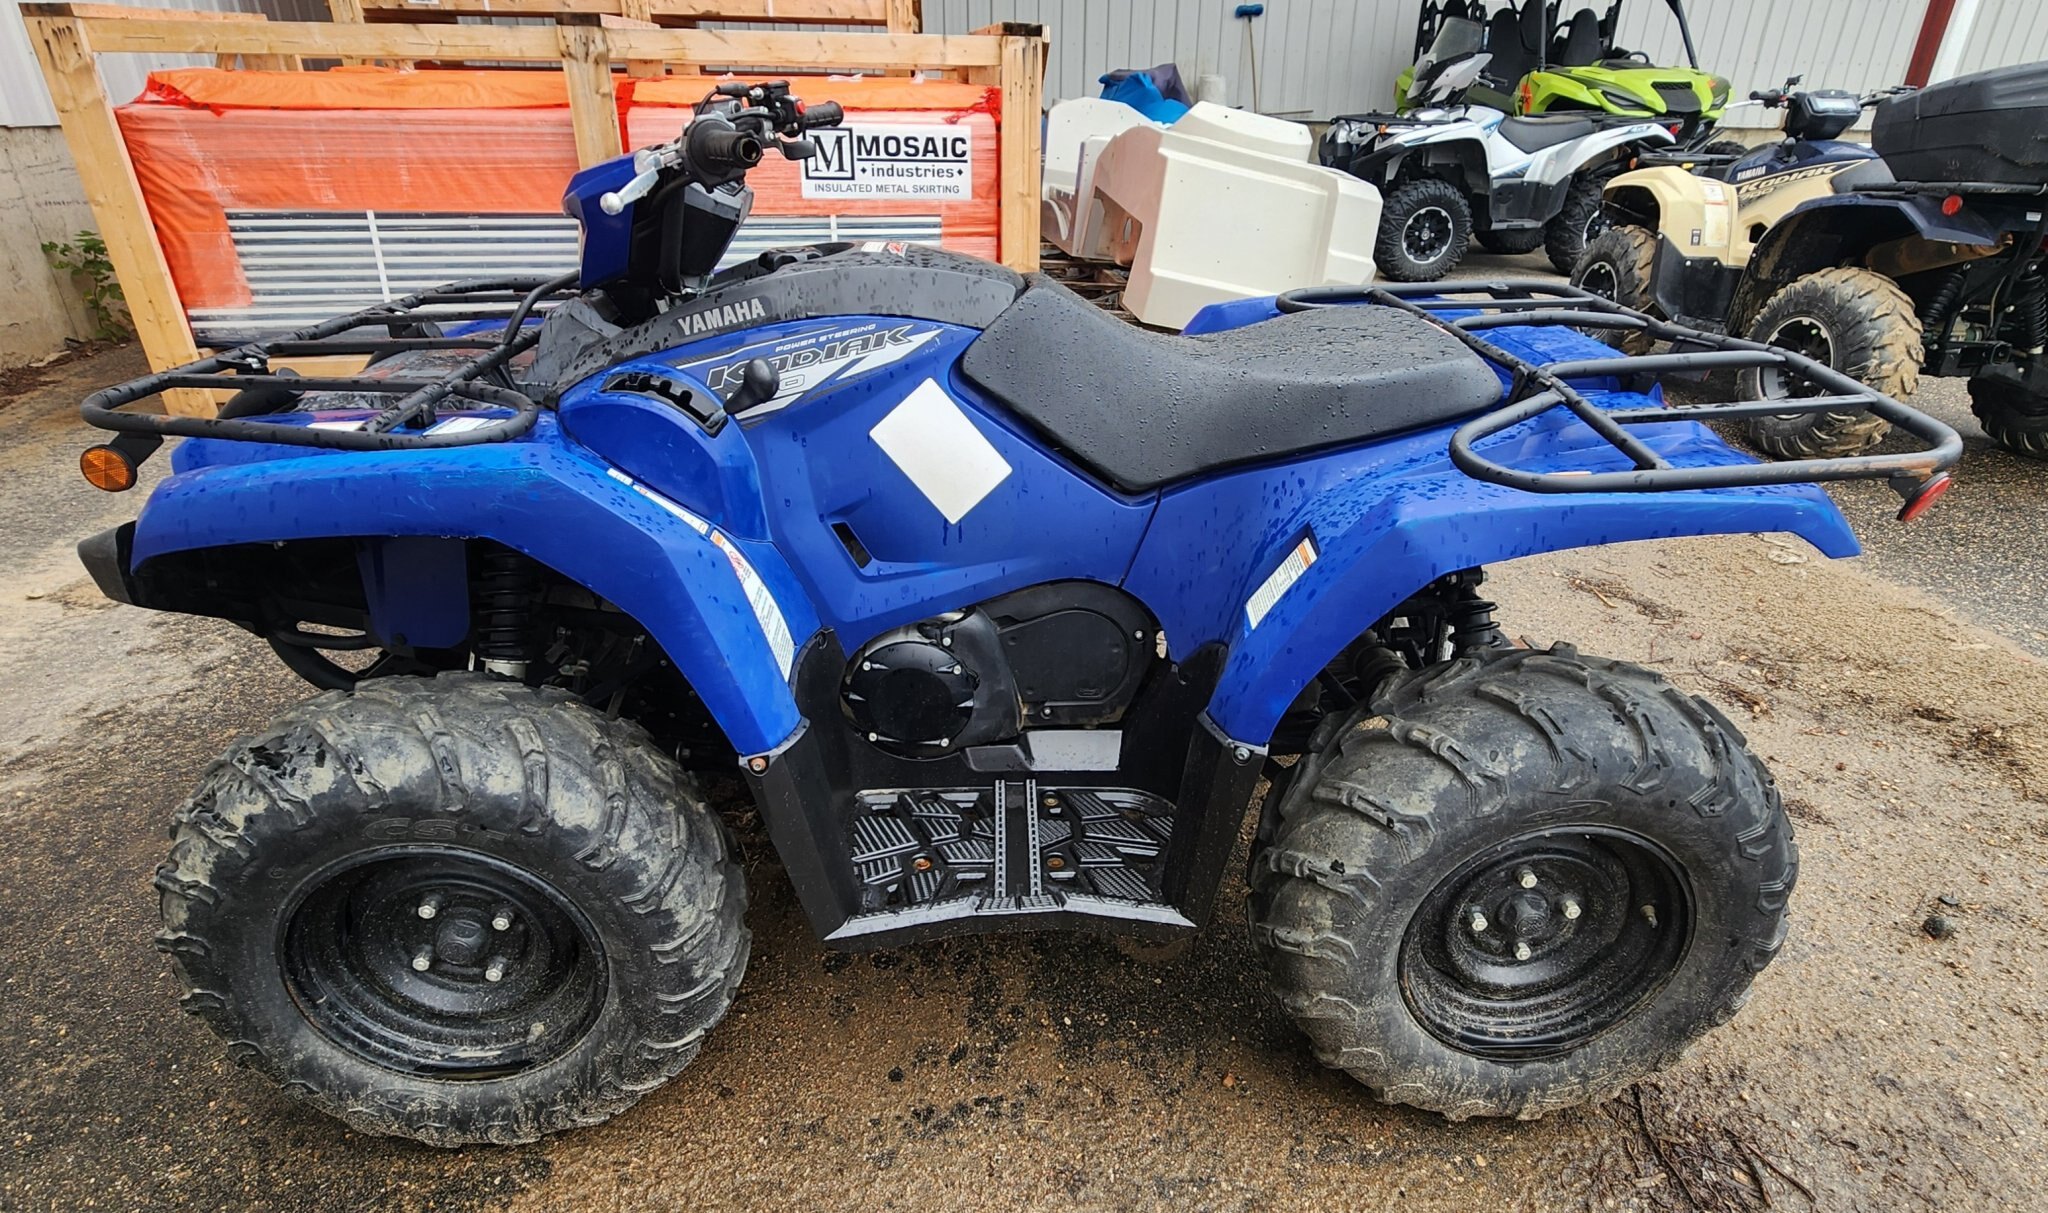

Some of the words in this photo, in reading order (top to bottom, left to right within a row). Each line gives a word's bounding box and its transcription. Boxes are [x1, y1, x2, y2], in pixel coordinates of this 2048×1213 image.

[809, 134, 849, 173] M
[856, 134, 968, 158] MOSAIC
[871, 163, 955, 178] industries
[1738, 165, 1838, 195] KODIAK
[814, 183, 873, 193] INSULATED
[875, 184, 909, 194] METAL
[912, 184, 960, 194] SKIRTING
[678, 298, 766, 336] YAMAHA
[775, 338, 816, 352] POWER
[819, 323, 876, 343] STEERING
